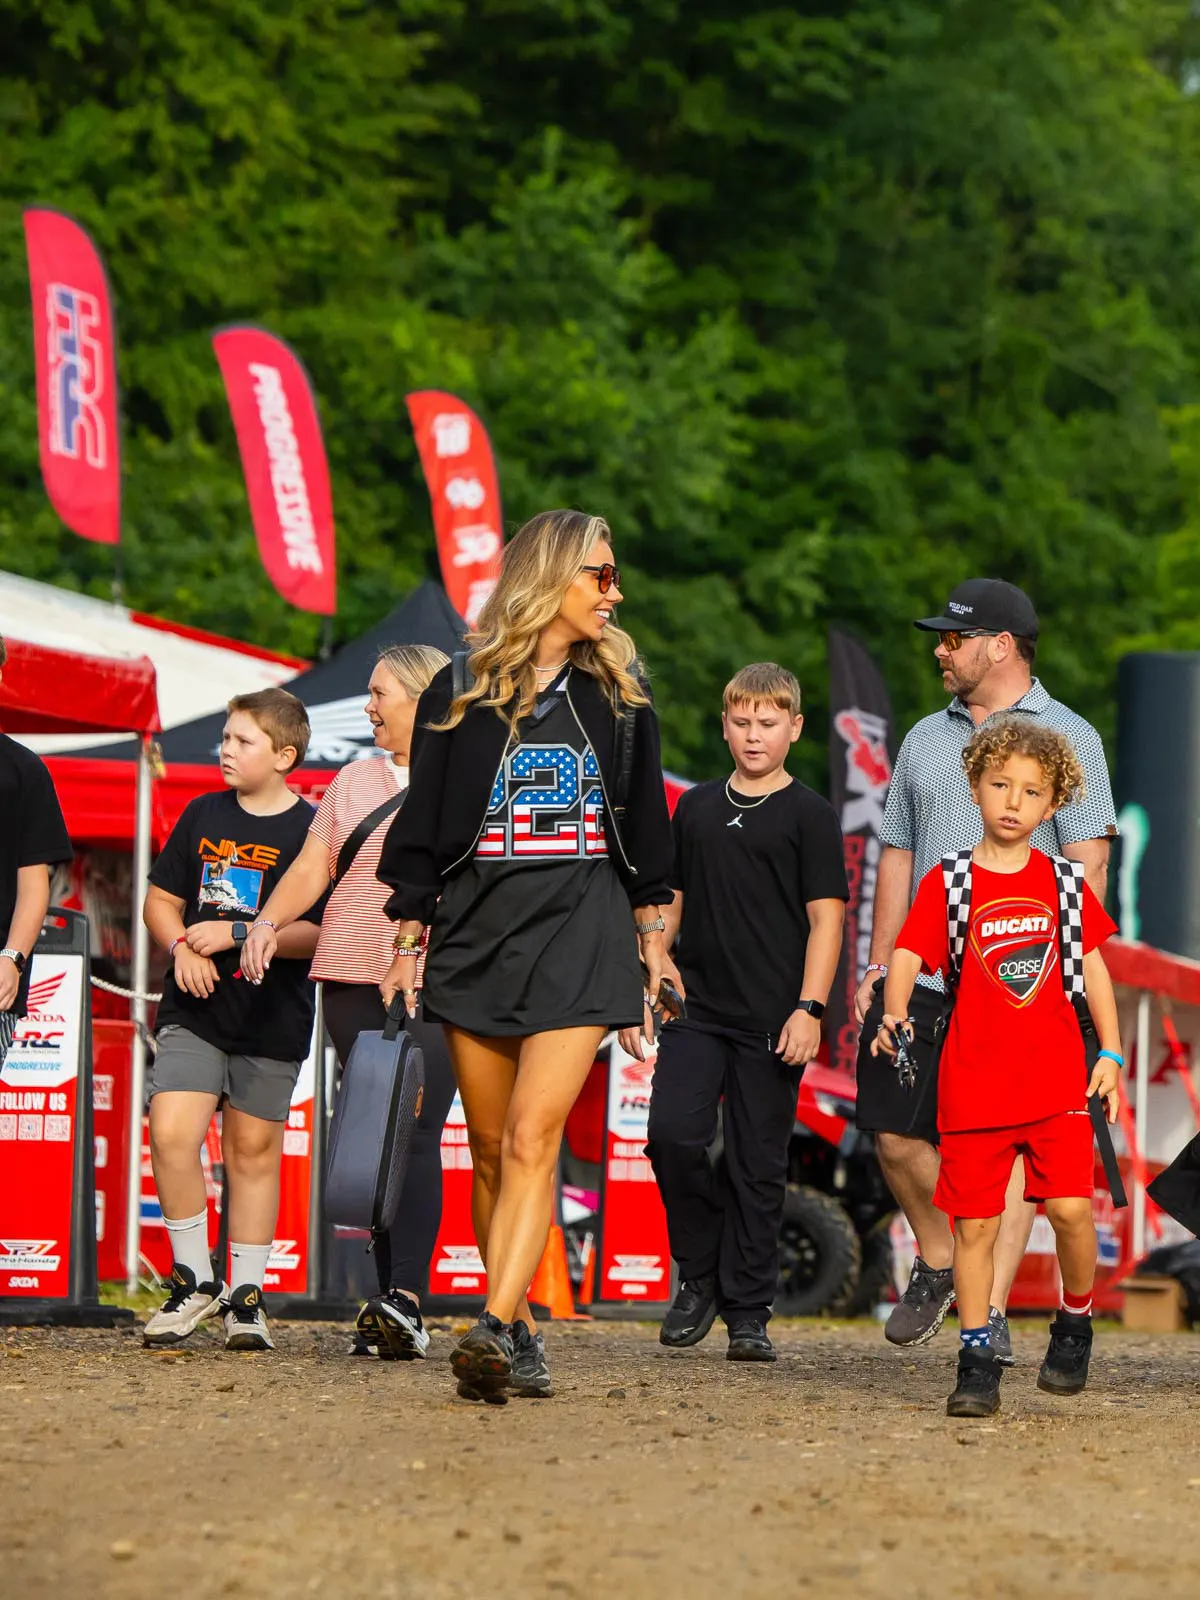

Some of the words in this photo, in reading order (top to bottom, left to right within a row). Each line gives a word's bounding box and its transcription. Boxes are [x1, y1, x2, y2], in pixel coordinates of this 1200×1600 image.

[49, 284, 107, 468] HRC
[198, 837, 281, 867] NIKE
[981, 916, 1048, 938] DUCATI
[998, 959, 1041, 976] CORSE
[19, 1014, 66, 1023] ONDA
[8, 1031, 64, 1049] HRC
[0, 1092, 46, 1110] FOLLOW
[49, 1092, 67, 1111] US
